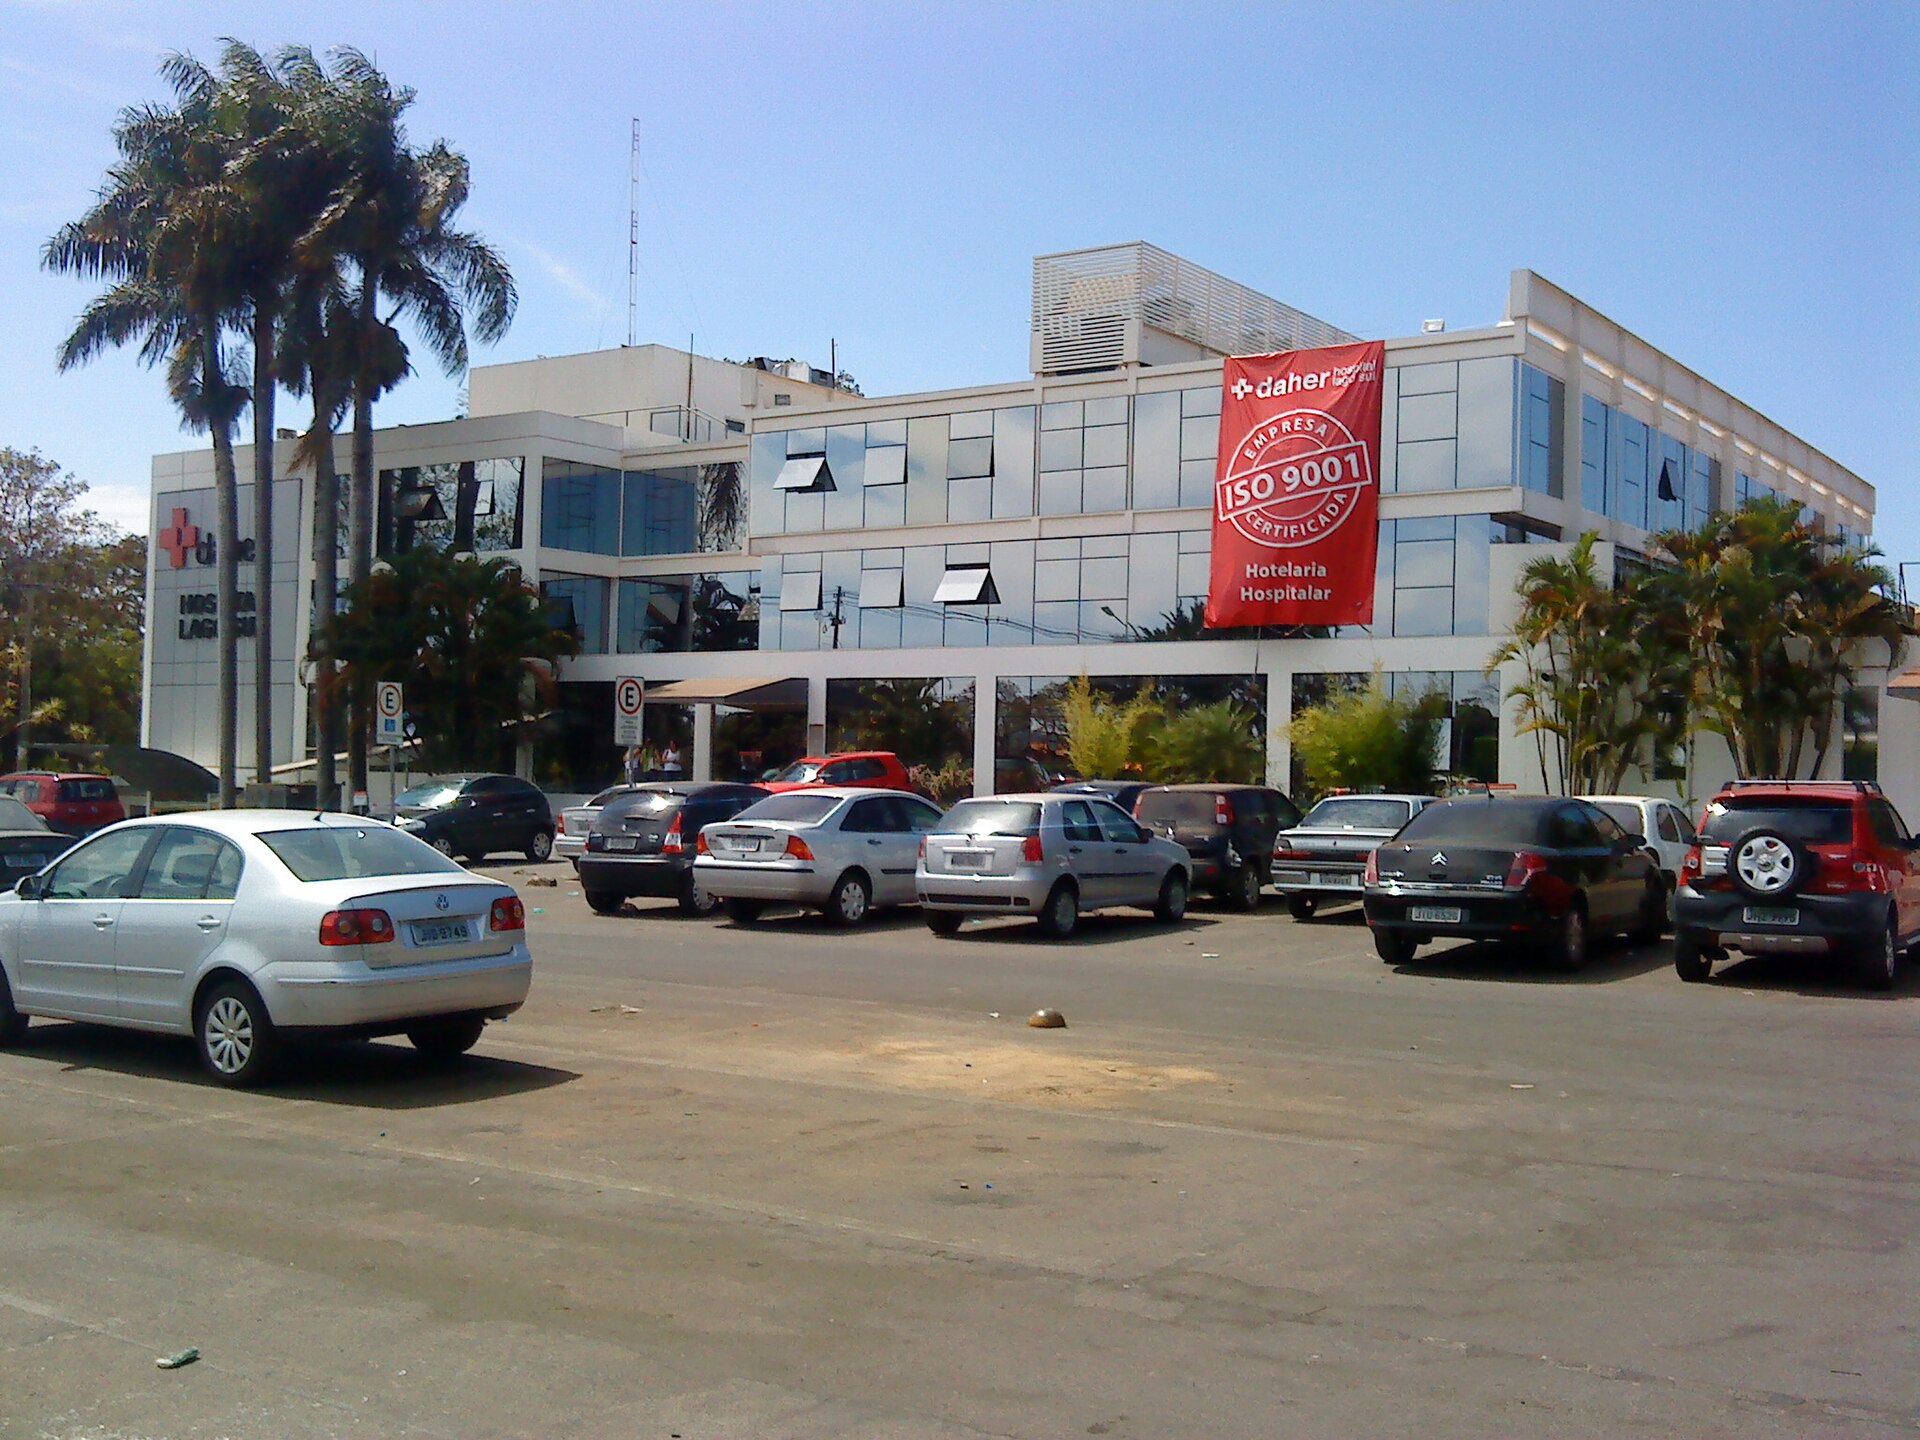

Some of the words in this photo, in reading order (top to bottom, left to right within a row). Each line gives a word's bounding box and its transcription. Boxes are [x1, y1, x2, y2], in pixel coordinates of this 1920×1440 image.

[1255, 371, 1331, 399] daher
[1243, 417, 1329, 460] EMPRESA
[1225, 473, 1275, 510] ISO
[1281, 452, 1360, 493] 9001
[1245, 491, 1348, 539] CERTIFICADA
[1245, 561, 1327, 579] Hotelaria
[1240, 584, 1332, 604] Hospitalar
[386, 692, 394, 709] E
[626, 686, 635, 707] E
